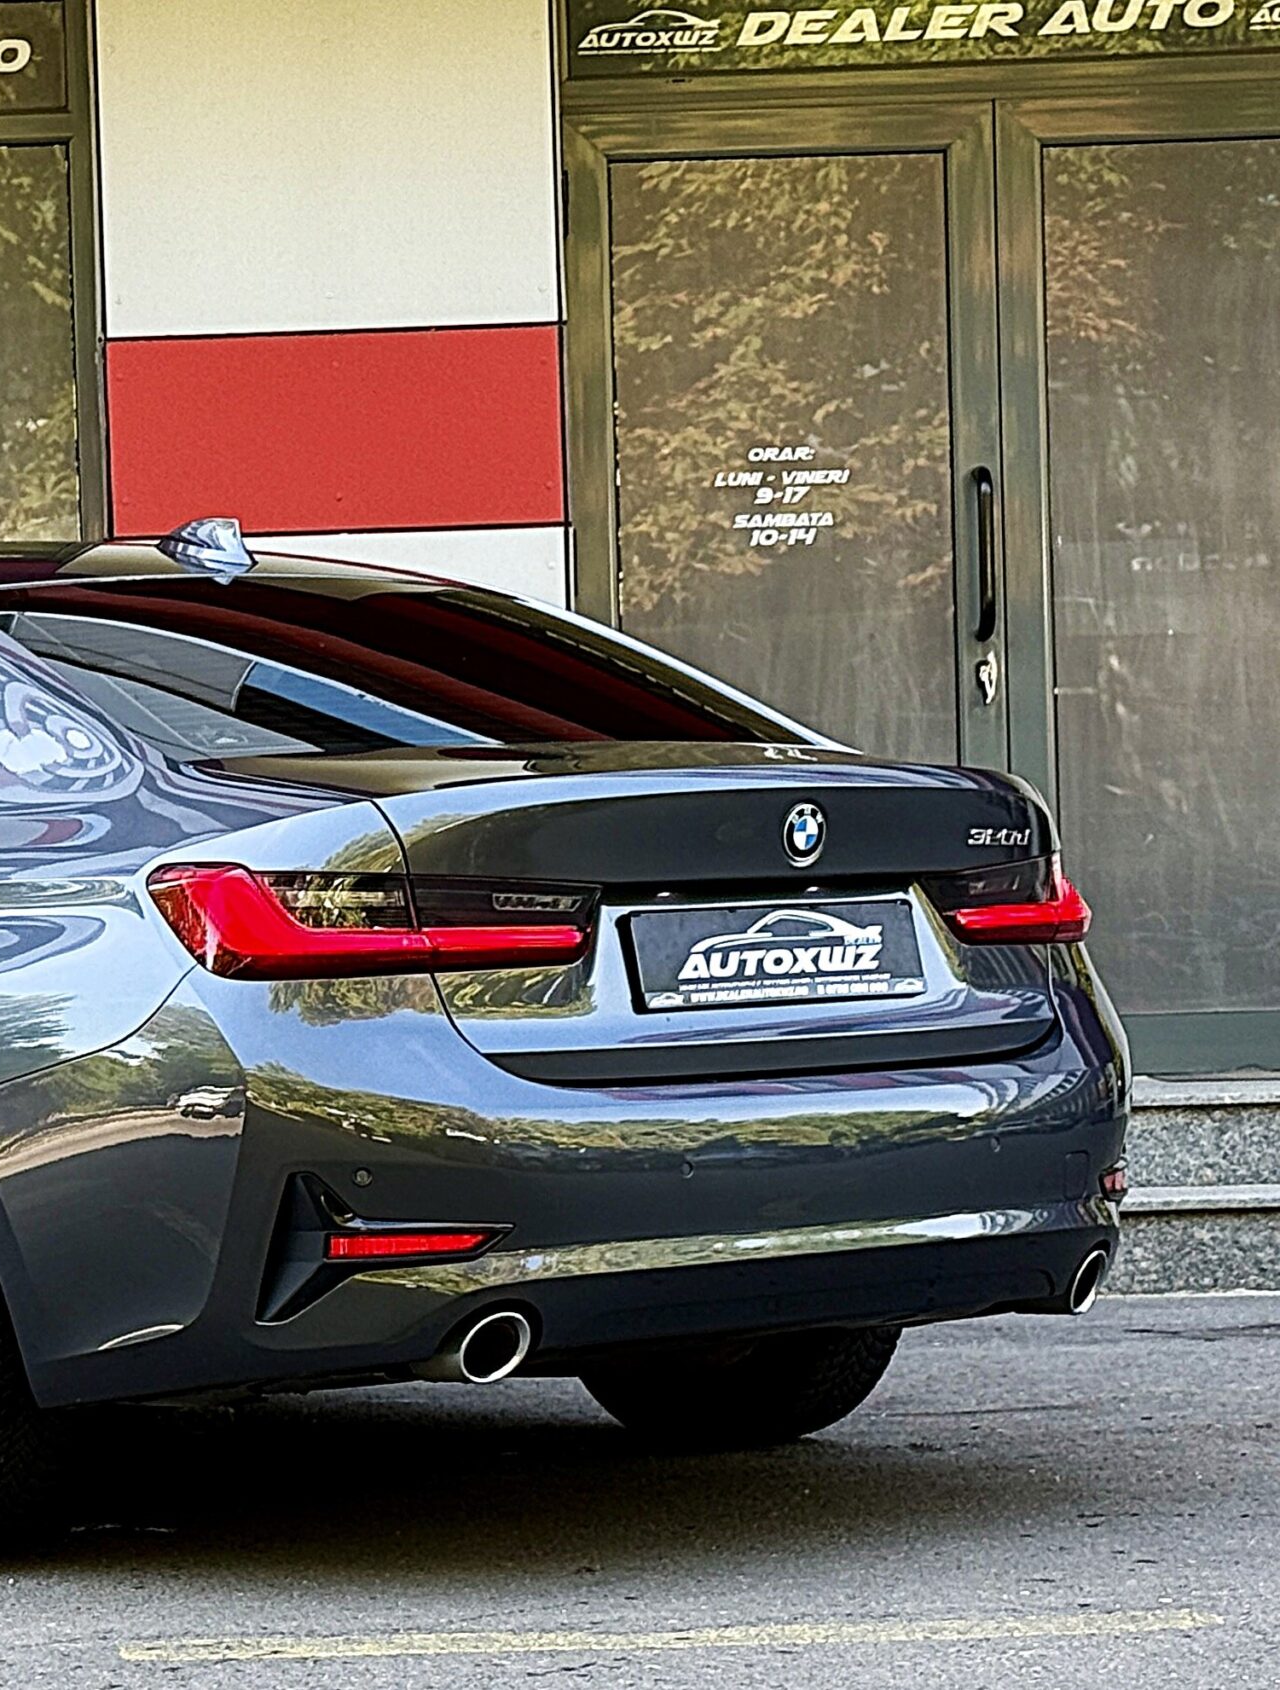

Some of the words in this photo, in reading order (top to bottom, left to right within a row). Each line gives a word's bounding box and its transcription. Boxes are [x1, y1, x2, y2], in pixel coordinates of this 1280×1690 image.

[736, 3, 1024, 46] DEALER
[1038, 0, 1234, 36] AUTO
[747, 446, 816, 462] ORAR:
[714, 471, 764, 487] LUNI
[782, 468, 850, 484] VINERI
[753, 486, 811, 504] 9-17
[733, 511, 834, 528] SAMBATA
[749, 527, 817, 546] 10-14
